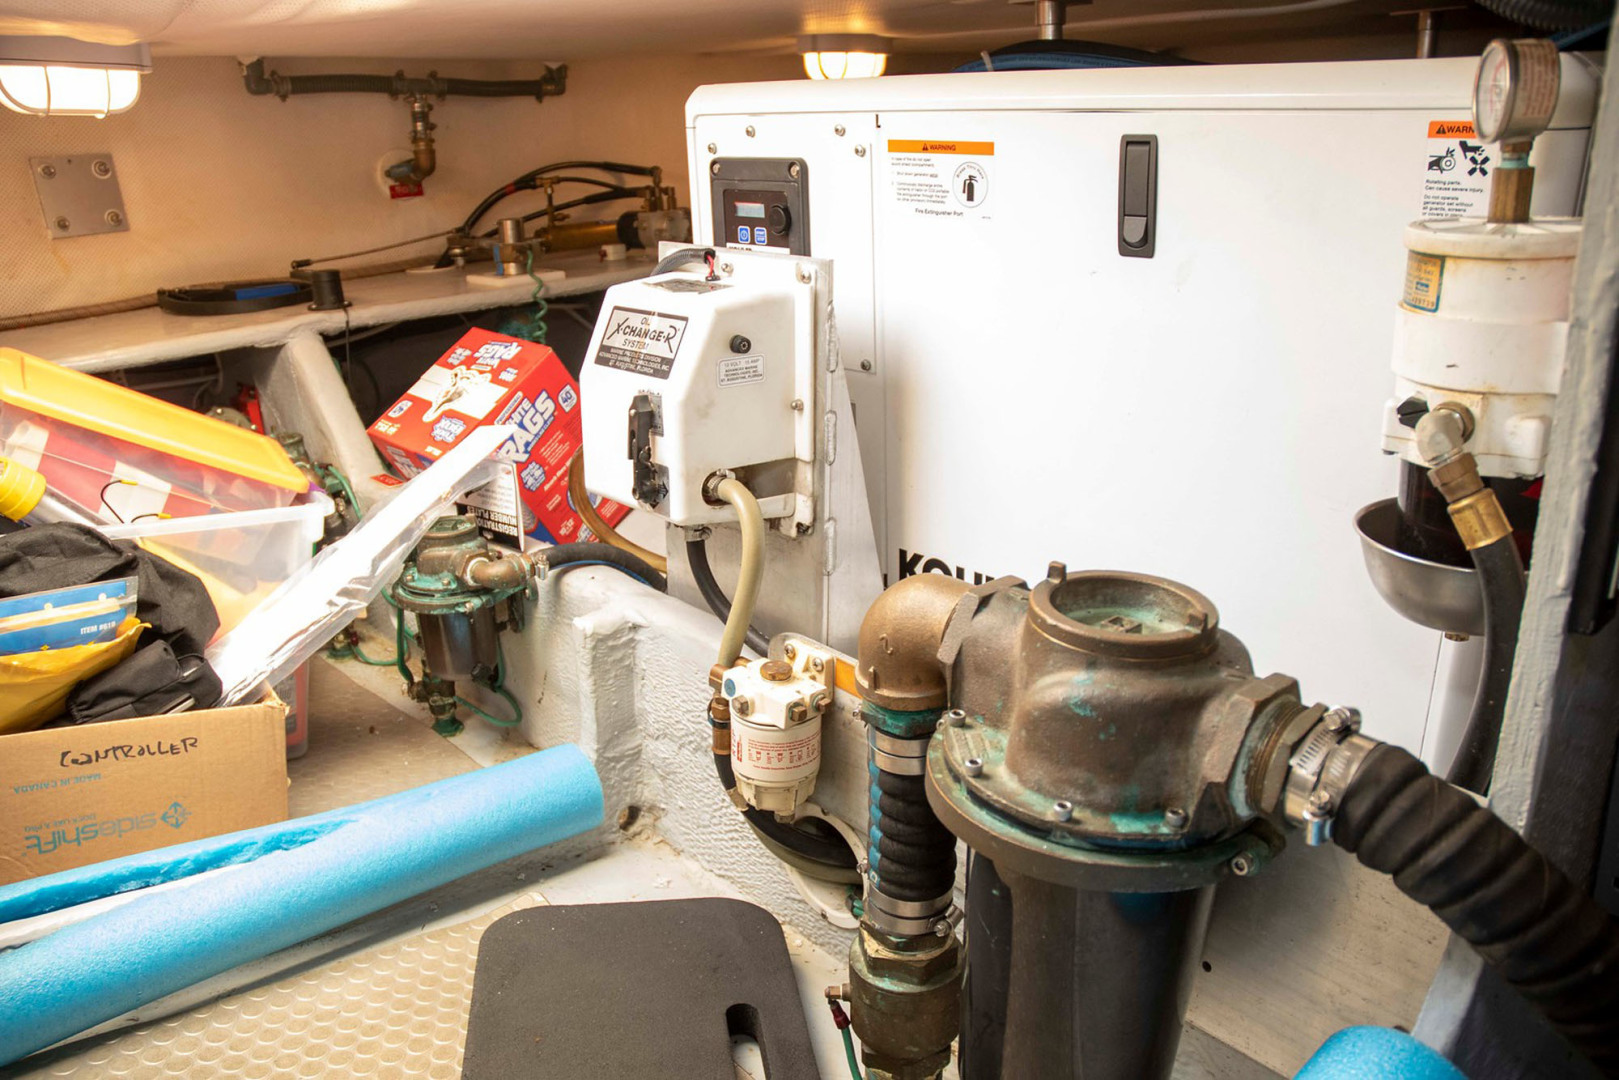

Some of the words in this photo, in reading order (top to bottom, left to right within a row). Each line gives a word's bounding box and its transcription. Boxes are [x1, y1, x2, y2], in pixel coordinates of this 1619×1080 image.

[1447, 126, 1475, 134] WARN
[561, 391, 572, 404] 40
[500, 390, 555, 462] RAGS
[489, 510, 516, 526] NUMBER
[475, 518, 517, 536] REGISTRATIO
[80, 622, 97, 635] ITEM
[60, 736, 198, 768] CONTROLLER
[60, 778, 70, 786] IN
[74, 772, 102, 784] MADE
[13, 781, 57, 795] CANADA
[24, 812, 157, 855] sideshift
